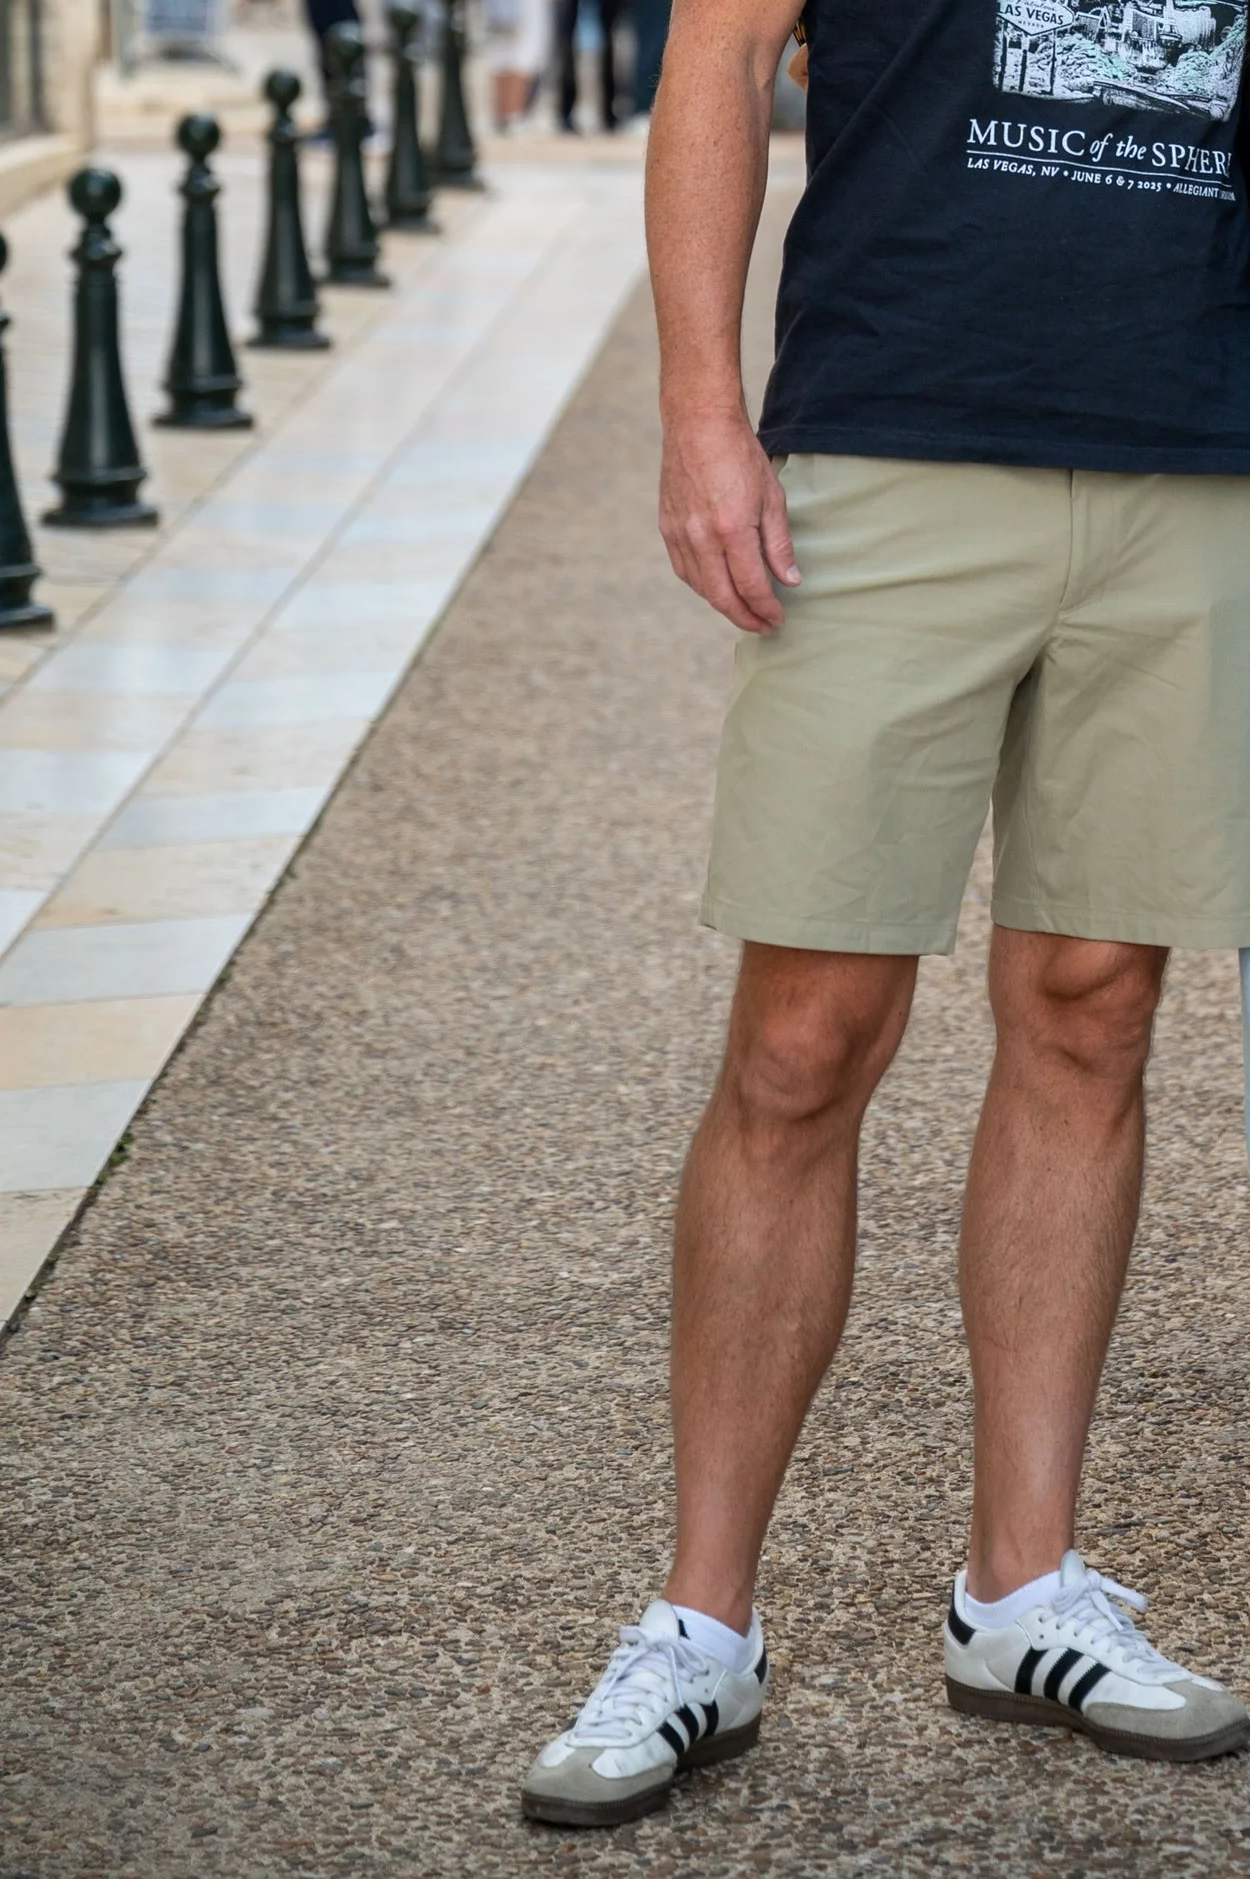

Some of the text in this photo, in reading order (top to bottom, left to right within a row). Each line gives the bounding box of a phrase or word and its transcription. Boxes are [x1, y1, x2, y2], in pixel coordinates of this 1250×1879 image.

[1003, 4, 1022, 17] AS
[1026, 7, 1064, 25] VEGAS
[966, 118, 1086, 156] MUSIC
[1089, 132, 1114, 162] of
[1115, 135, 1147, 160] the
[967, 158, 990, 170] LAS
[993, 159, 1036, 177] VEGAS,
[1041, 166, 1060, 177] NV
[1071, 170, 1101, 184] JUNE
[1105, 174, 1113, 185] 6
[1116, 175, 1125, 186] &
[1127, 180, 1134, 189] 7
[1137, 181, 1162, 192] 2025
[1173, 182, 1219, 198] ALLEGIANT
